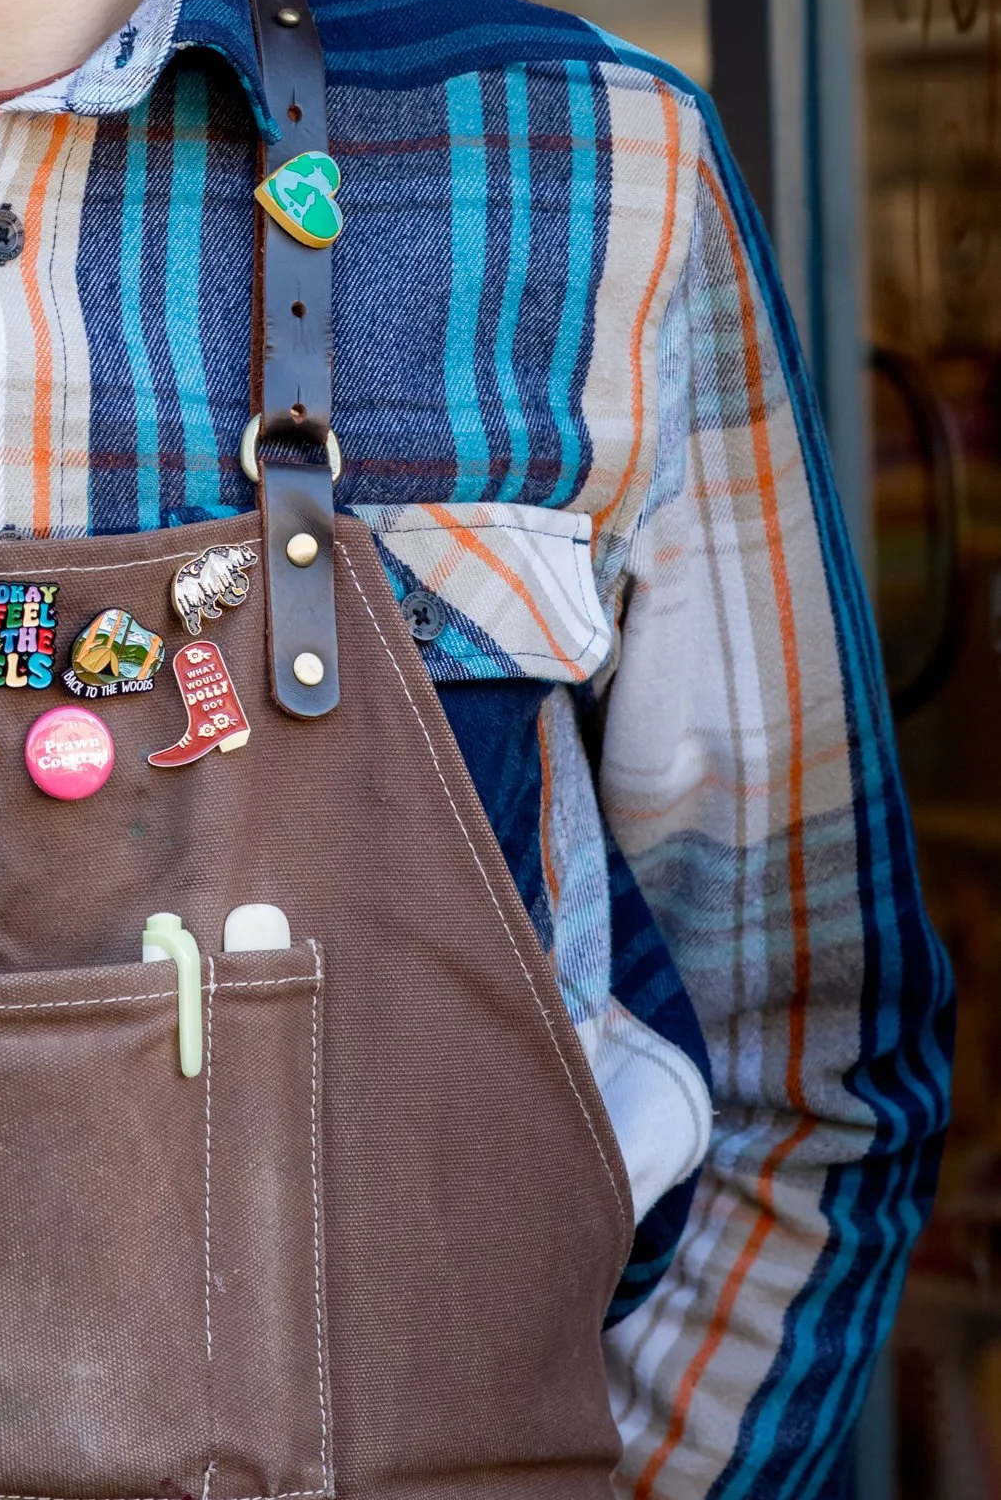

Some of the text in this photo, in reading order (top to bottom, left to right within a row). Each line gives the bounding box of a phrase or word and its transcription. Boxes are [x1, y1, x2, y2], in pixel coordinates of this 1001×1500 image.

[0, 627, 53, 655] THE
[186, 663, 215, 679] WHAT
[63, 670, 153, 698] BACK TO THE WOODS
[186, 672, 223, 690] WOULD
[186, 681, 228, 706] DOLLY
[202, 699, 223, 712] DO?
[44, 737, 100, 754] Prawn
